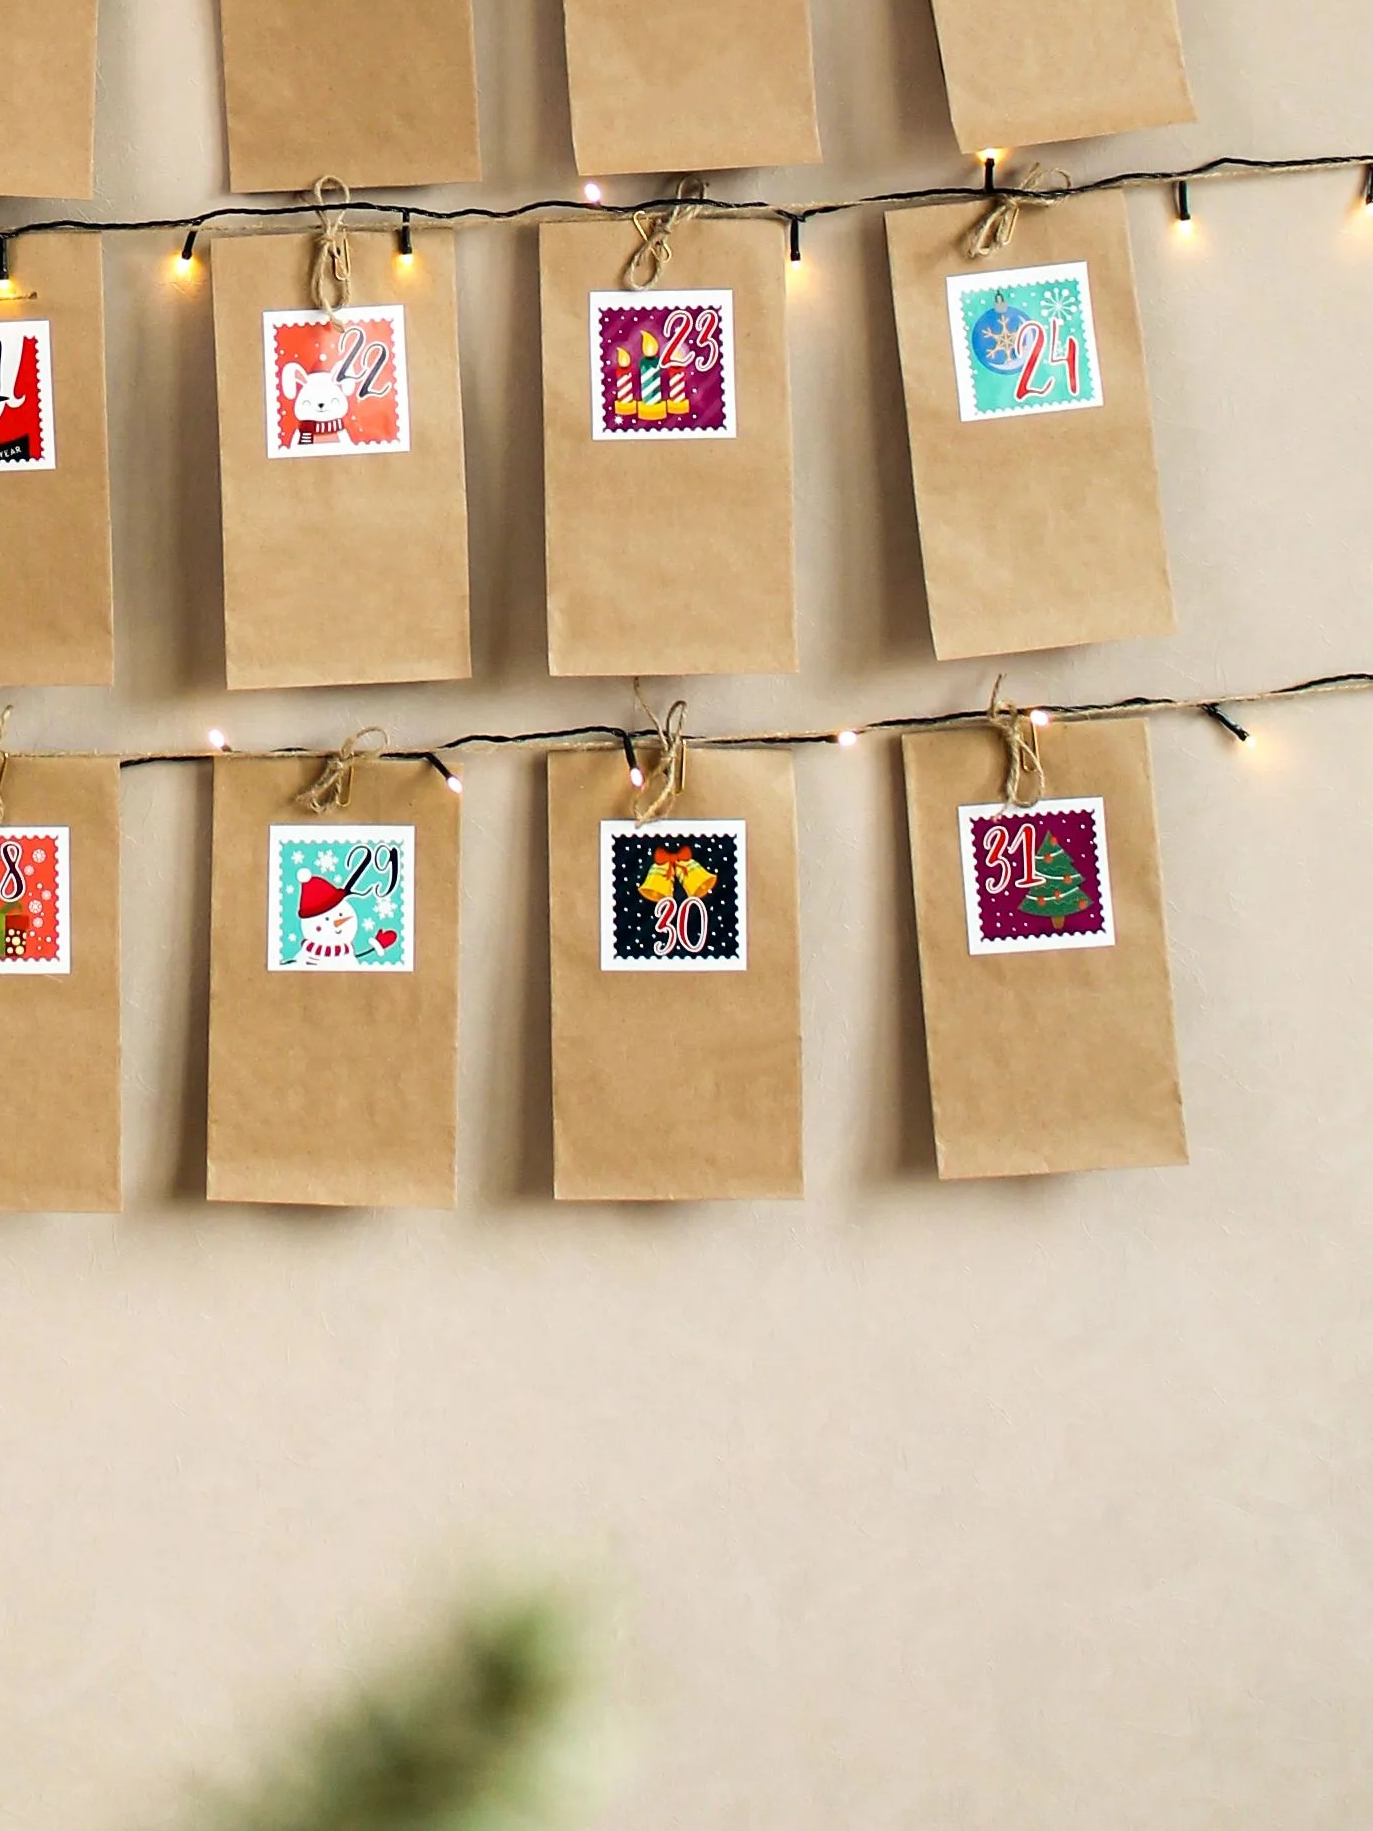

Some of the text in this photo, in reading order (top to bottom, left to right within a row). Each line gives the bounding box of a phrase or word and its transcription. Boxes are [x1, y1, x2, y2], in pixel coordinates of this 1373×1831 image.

[336, 327, 391, 399] 22
[658, 308, 719, 371] 23
[1014, 319, 1080, 400] 24
[344, 844, 399, 897] 29
[983, 823, 1047, 894] 31
[653, 896, 708, 955] 30
